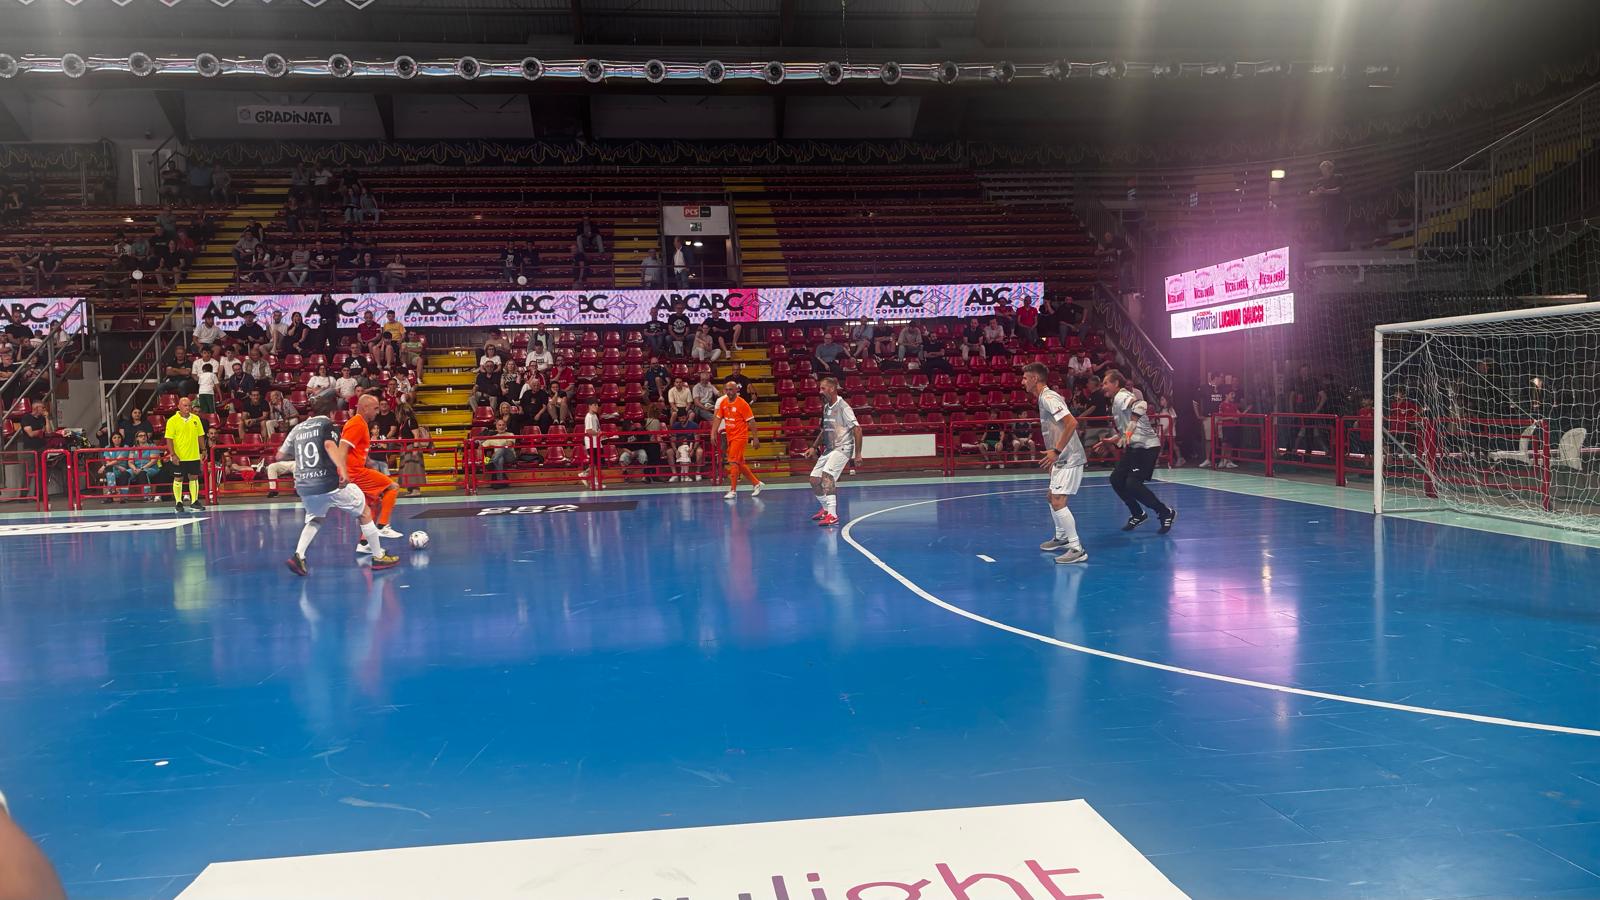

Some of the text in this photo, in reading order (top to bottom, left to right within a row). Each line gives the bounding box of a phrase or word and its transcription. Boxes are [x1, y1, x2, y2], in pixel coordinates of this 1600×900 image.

[404, 296, 457, 315] ABC
[503, 295, 555, 314] ABC
[786, 291, 835, 310] ABC
[876, 290, 924, 308] ABC
[965, 287, 1012, 306] ABC
[202, 299, 256, 319] ABC
[305, 298, 358, 317] AC
[1192, 312, 1218, 332] Memorial
[297, 441, 319, 470] 19
